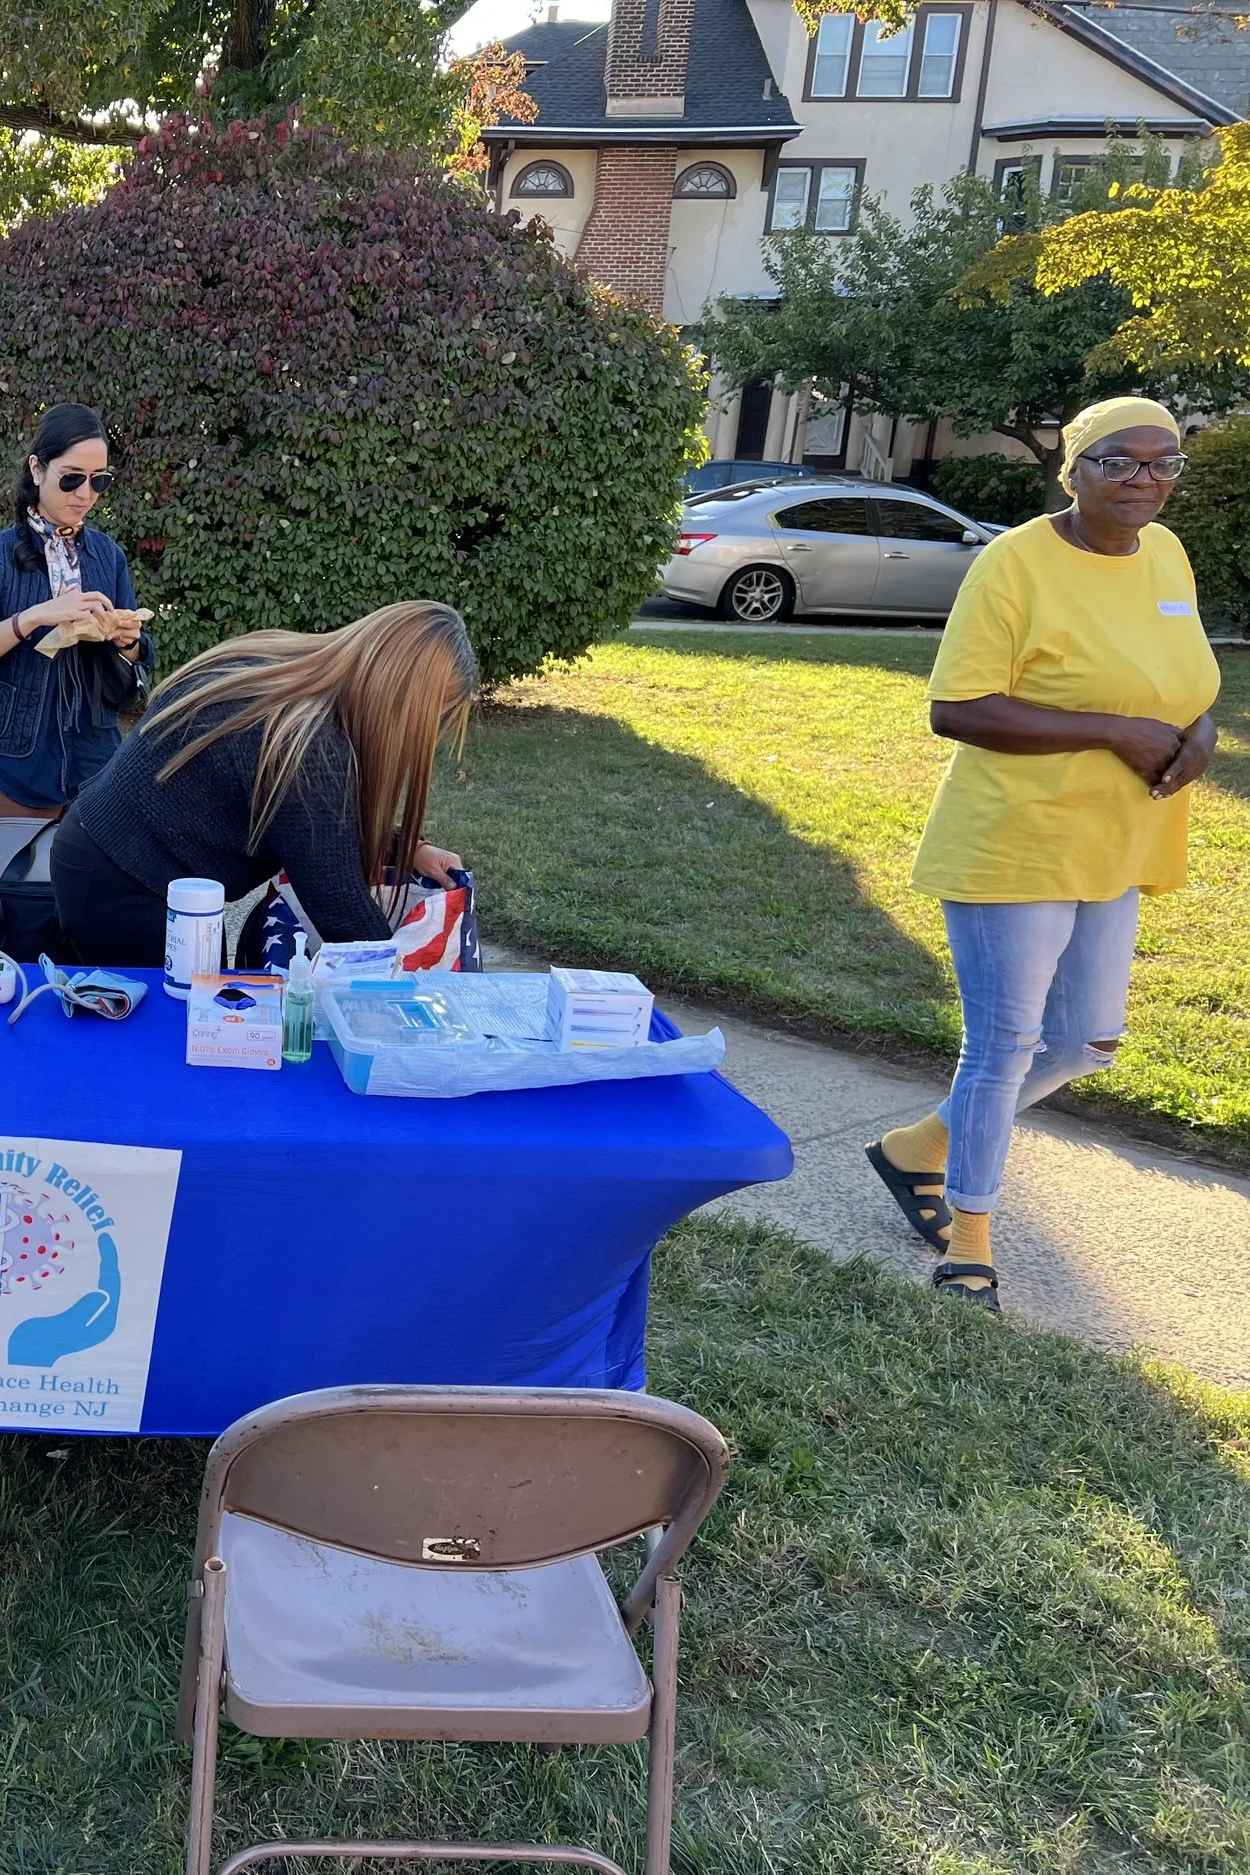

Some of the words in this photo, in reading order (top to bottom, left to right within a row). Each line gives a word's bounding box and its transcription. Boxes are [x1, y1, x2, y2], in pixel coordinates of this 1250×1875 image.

[250, 1031, 260, 1040] 90
[241, 1047, 269, 1056] Gloves
[44, 1162, 114, 1232] Relief
[39, 1374, 119, 1395] Health
[74, 1400, 108, 1417] NJ
